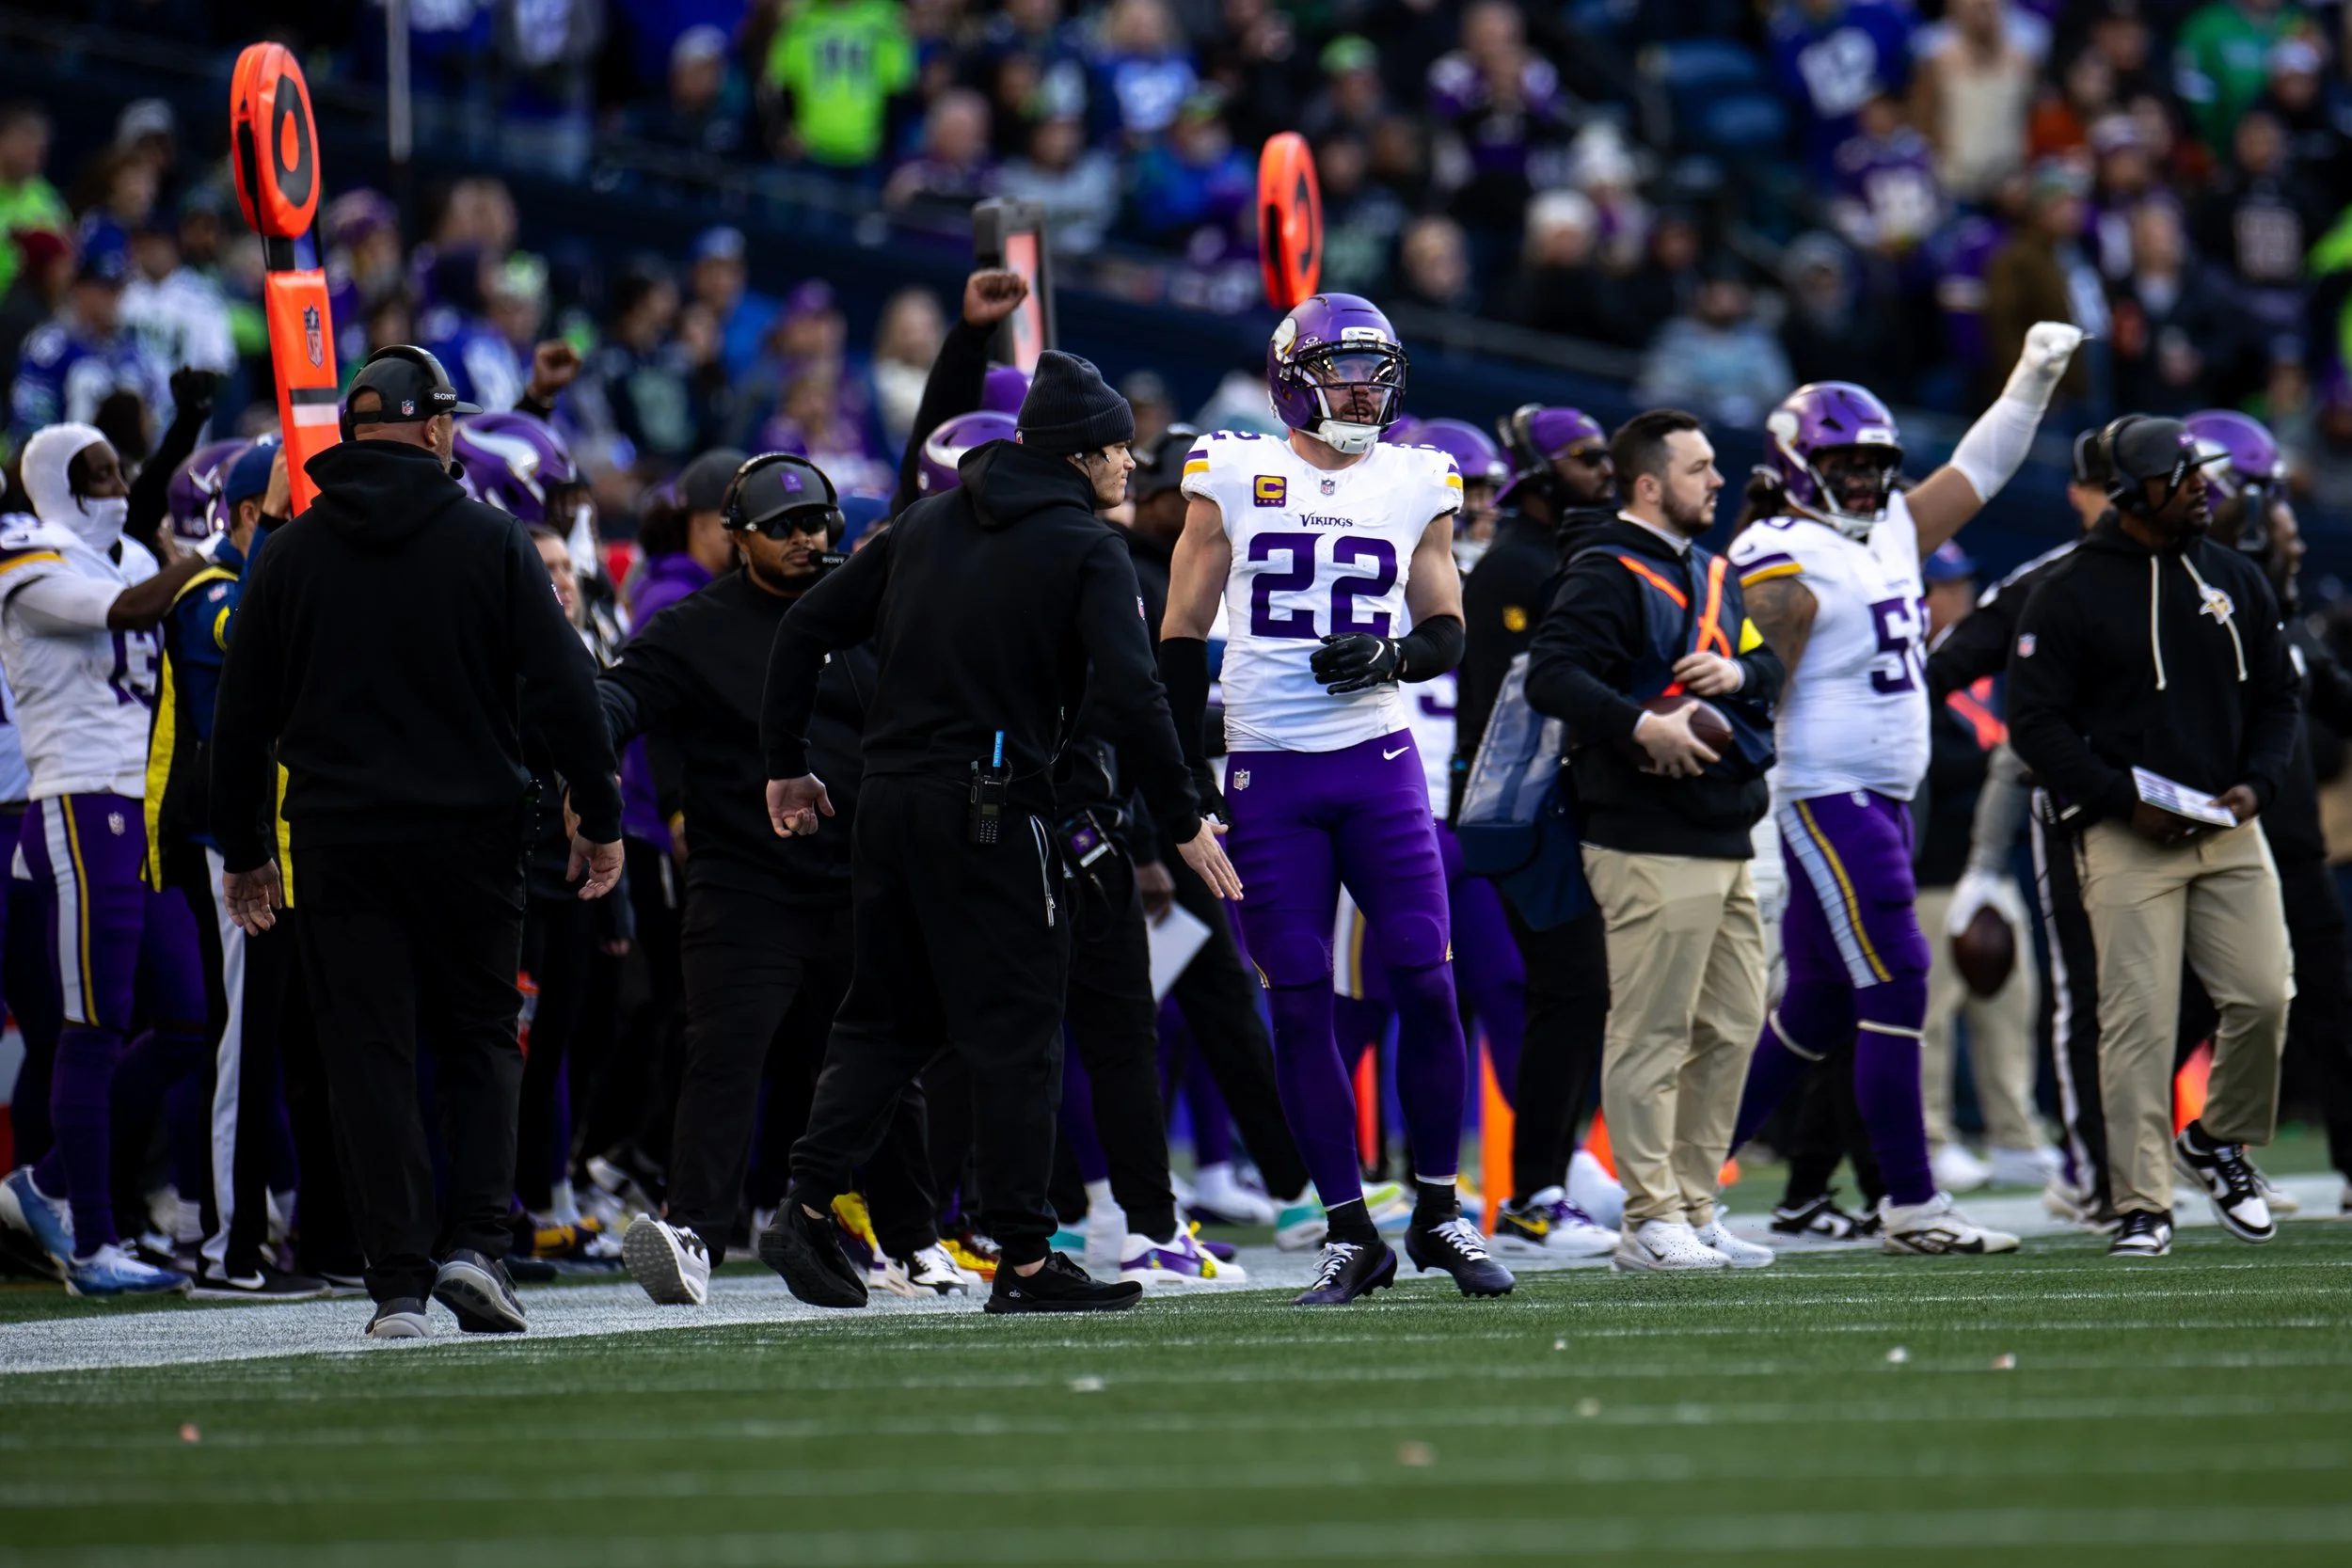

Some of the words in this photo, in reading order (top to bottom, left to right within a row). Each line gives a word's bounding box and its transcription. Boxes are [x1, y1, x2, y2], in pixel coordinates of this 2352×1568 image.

[433, 392, 456, 401] SONY
[1255, 476, 1285, 499] C
[1299, 512, 1354, 528] VIKINGS
[1248, 531, 1398, 640] 22
[1009, 1290, 1021, 1298] alo
